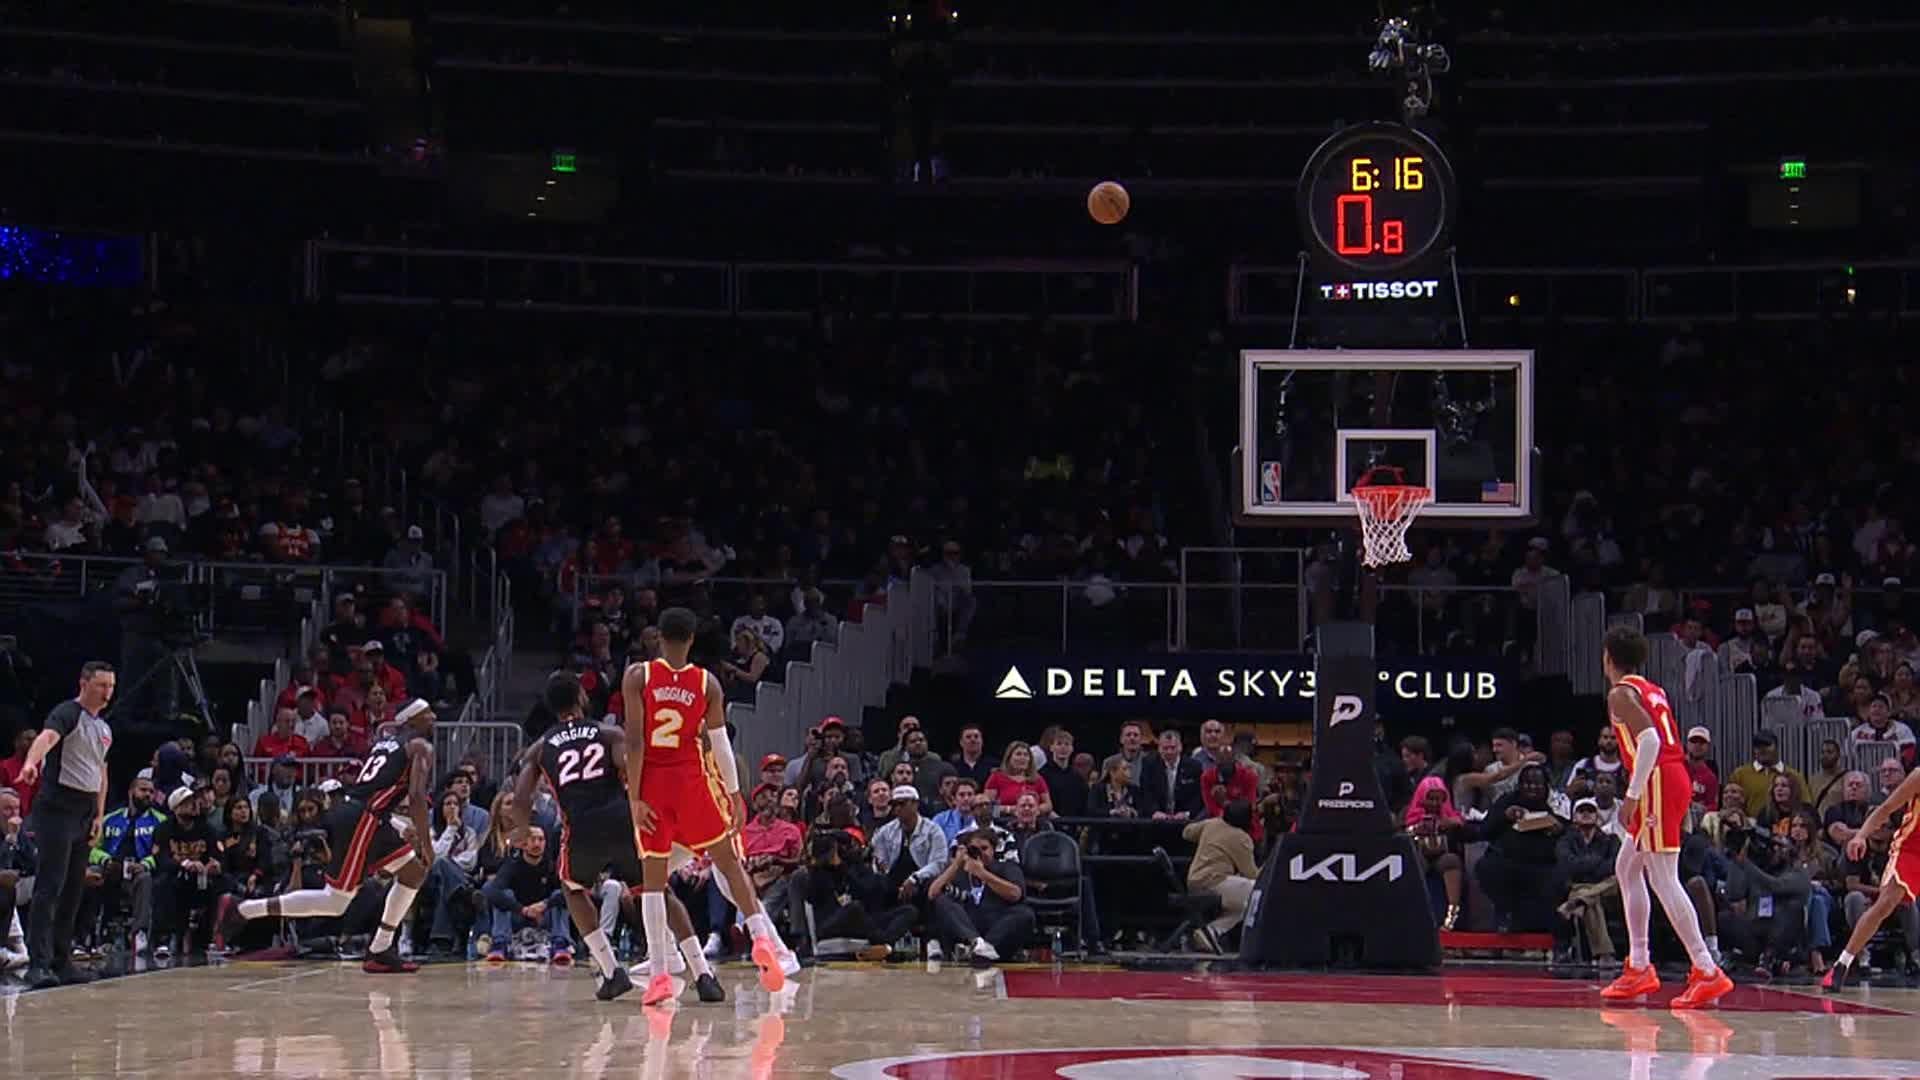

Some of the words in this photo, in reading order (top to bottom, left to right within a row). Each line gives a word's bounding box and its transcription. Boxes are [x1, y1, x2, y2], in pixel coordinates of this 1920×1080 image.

[1352, 157, 1423, 191] 6:16
[1337, 195, 1403, 254] 0.8
[1352, 281, 1438, 298] TISSOT
[1047, 668, 1198, 697] DELTA
[549, 726, 598, 747] WIGGINS
[651, 708, 683, 748] 2
[356, 755, 387, 784] 13
[558, 743, 605, 786] 22
[1289, 853, 1403, 882] KIA
